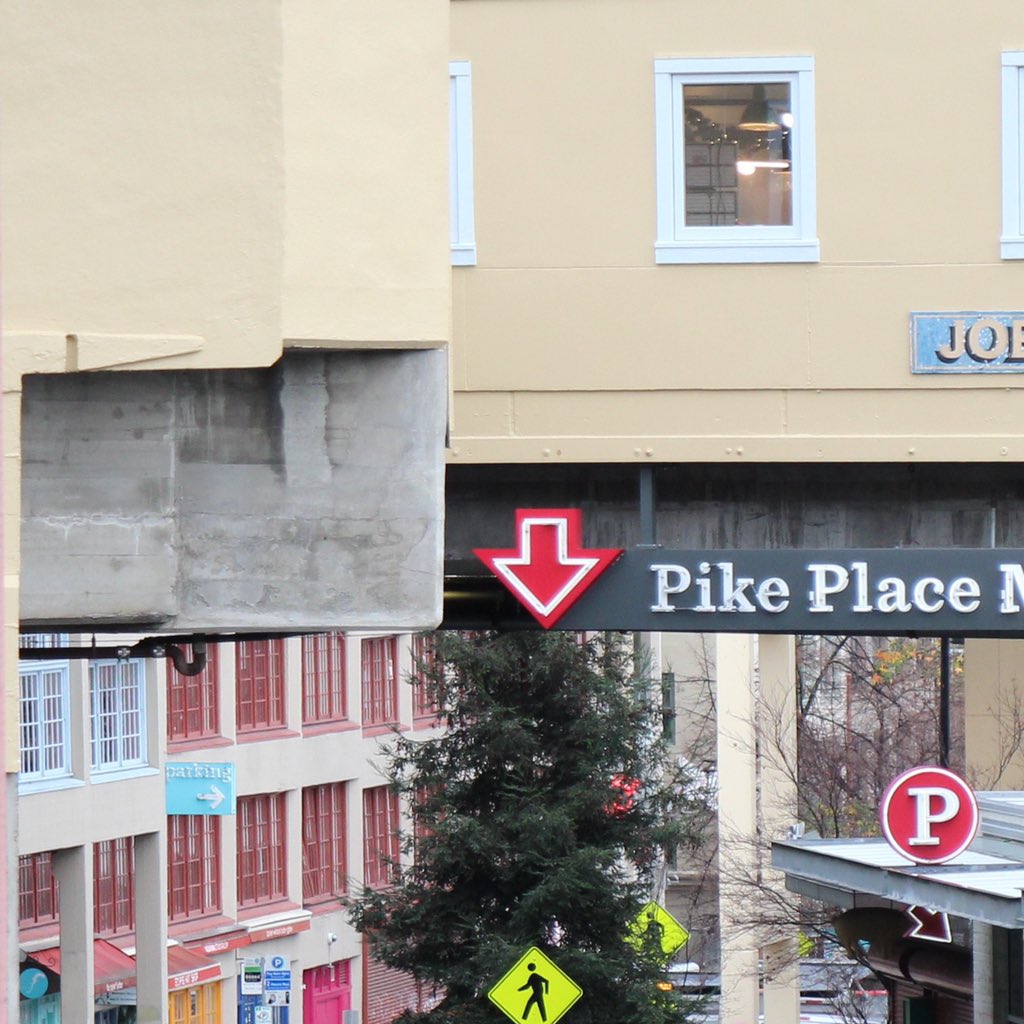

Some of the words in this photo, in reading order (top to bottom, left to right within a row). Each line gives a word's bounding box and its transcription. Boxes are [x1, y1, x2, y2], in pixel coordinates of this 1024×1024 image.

[650, 562, 790, 614] Pike
[807, 562, 981, 614] Place
[166, 763, 232, 783] parking
[907, 787, 960, 846] P
